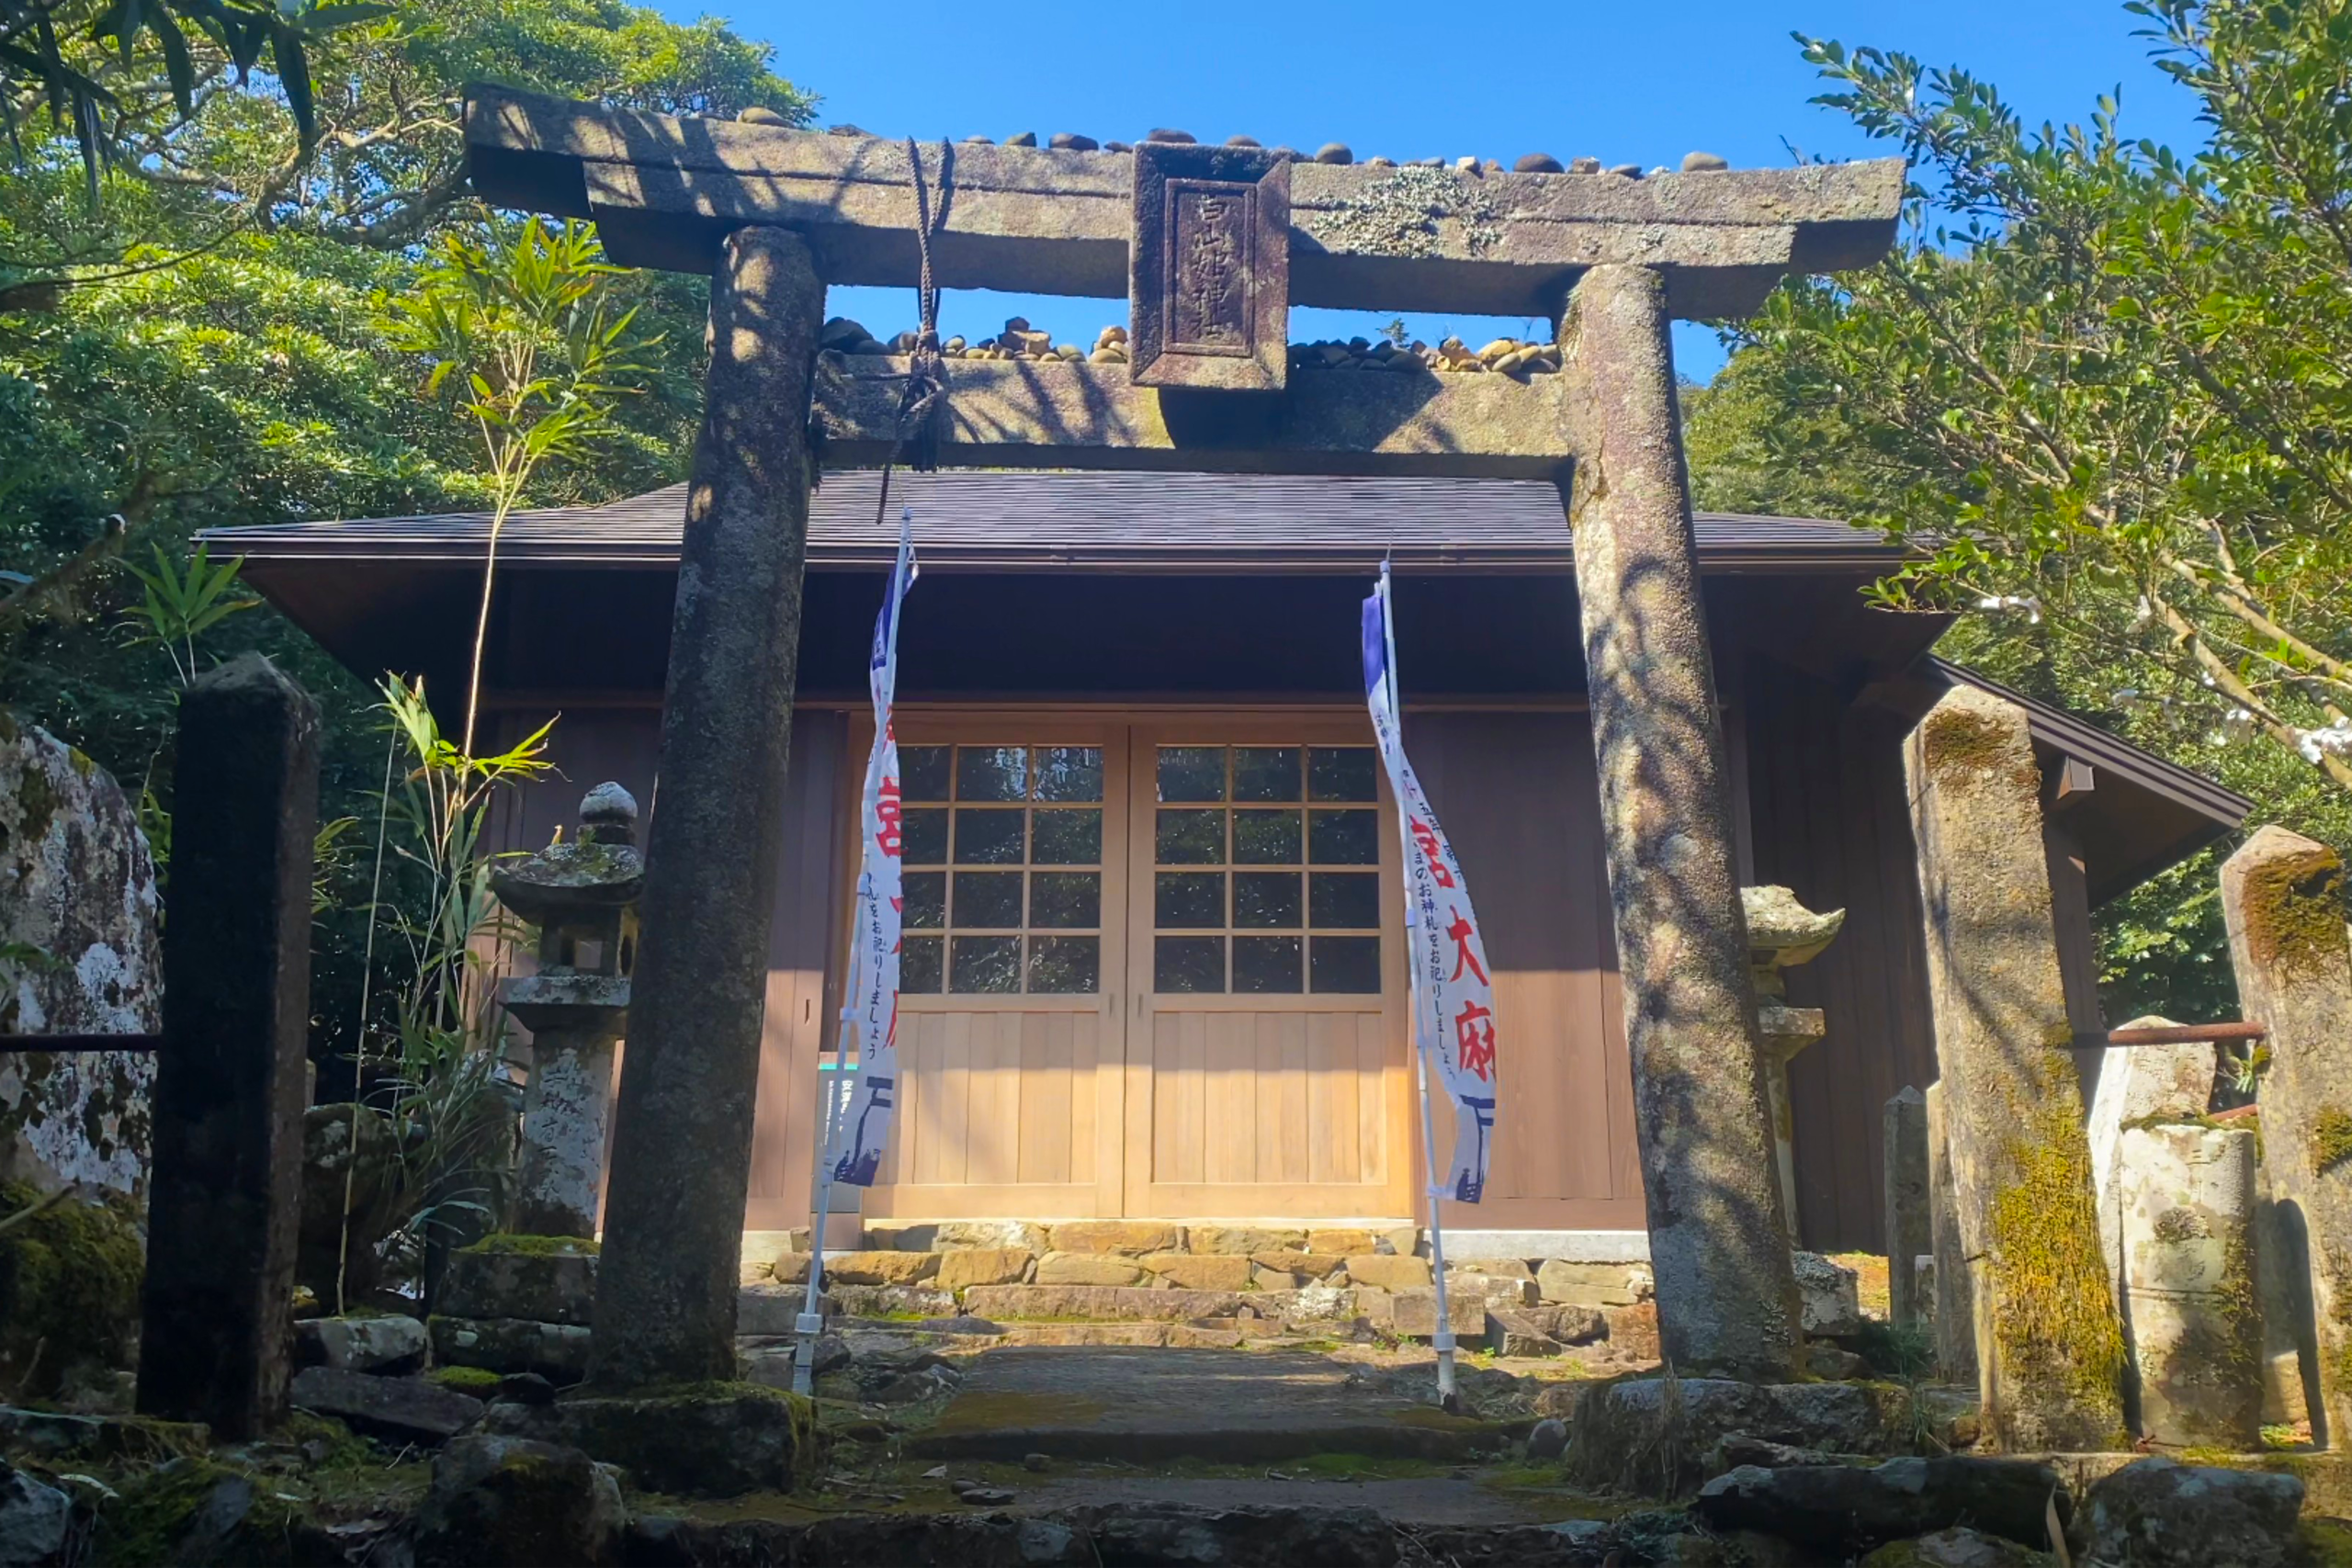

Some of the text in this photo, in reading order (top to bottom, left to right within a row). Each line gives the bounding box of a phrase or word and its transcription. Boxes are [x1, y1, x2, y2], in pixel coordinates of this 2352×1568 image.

[1405, 781, 1497, 1084] 宮大麻
[1413, 839, 1457, 1082] まのお神札をお祀りしましょう
